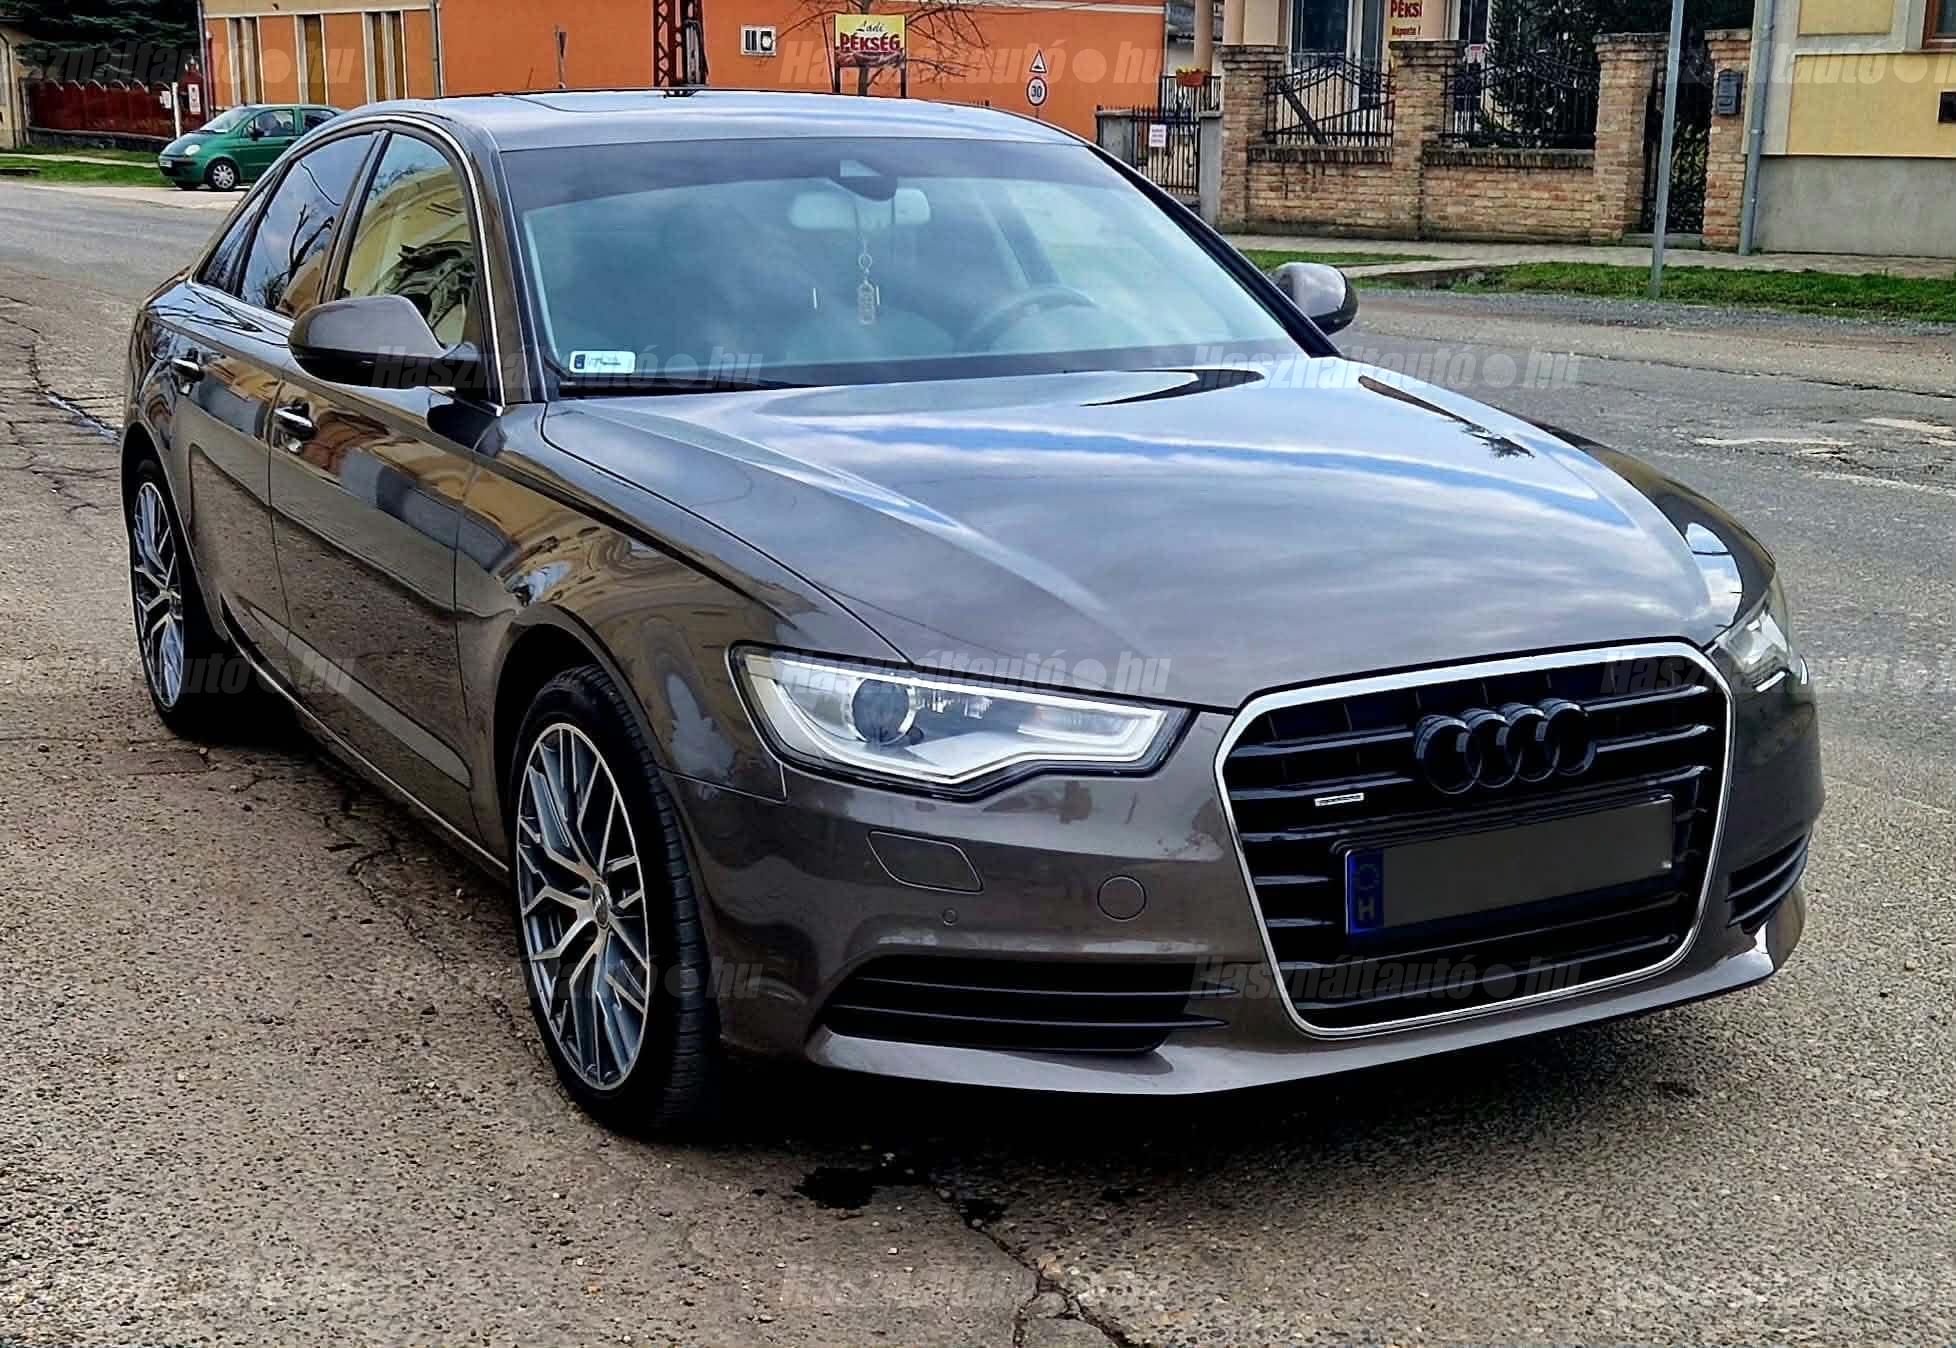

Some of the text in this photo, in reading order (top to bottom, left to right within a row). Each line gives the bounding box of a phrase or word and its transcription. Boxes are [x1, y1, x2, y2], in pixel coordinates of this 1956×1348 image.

[839, 32, 900, 51] PÉKSÉG
[1031, 85, 1043, 98] 30
[1358, 897, 1375, 921] H
